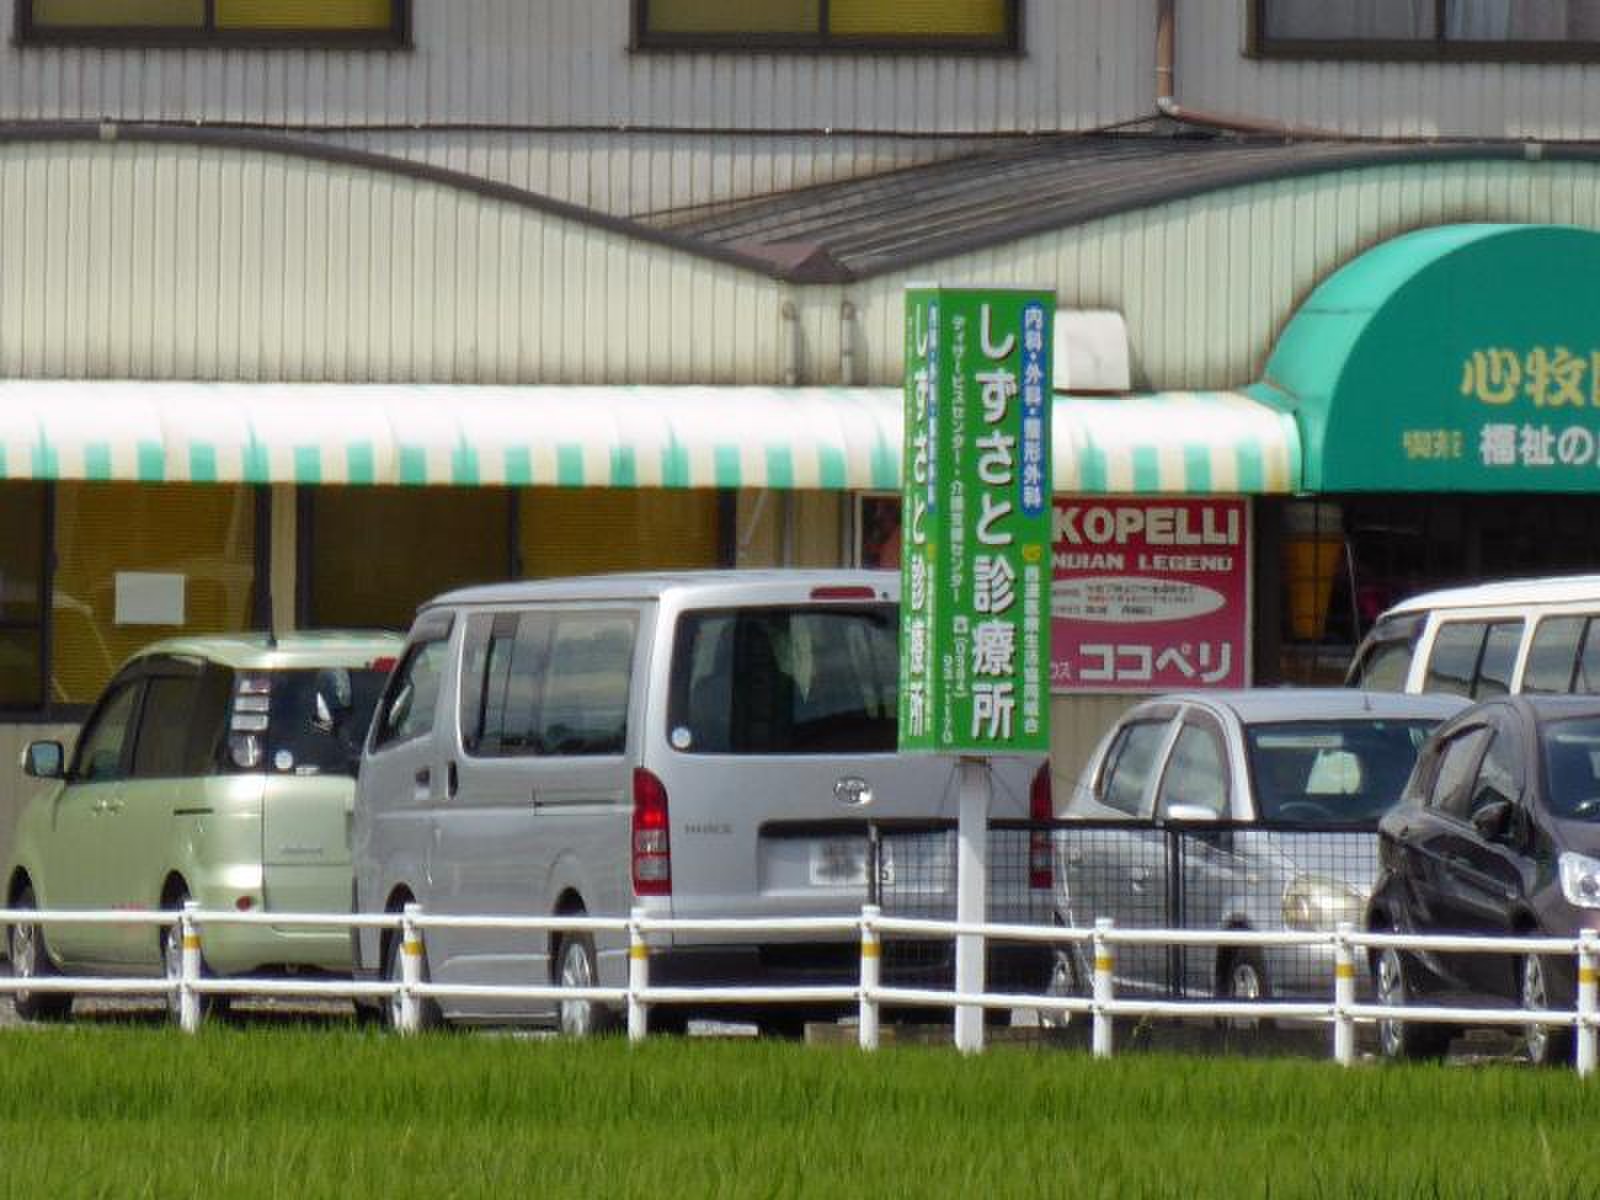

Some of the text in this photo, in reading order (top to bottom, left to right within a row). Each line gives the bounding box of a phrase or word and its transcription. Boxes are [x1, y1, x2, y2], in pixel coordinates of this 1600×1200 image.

[1480, 424, 1600, 467] 福祉の
[971, 303, 1018, 740] しずさと診療所
[1139, 555, 1233, 571] LEGEND
[1079, 642, 1231, 683] ココペリ
